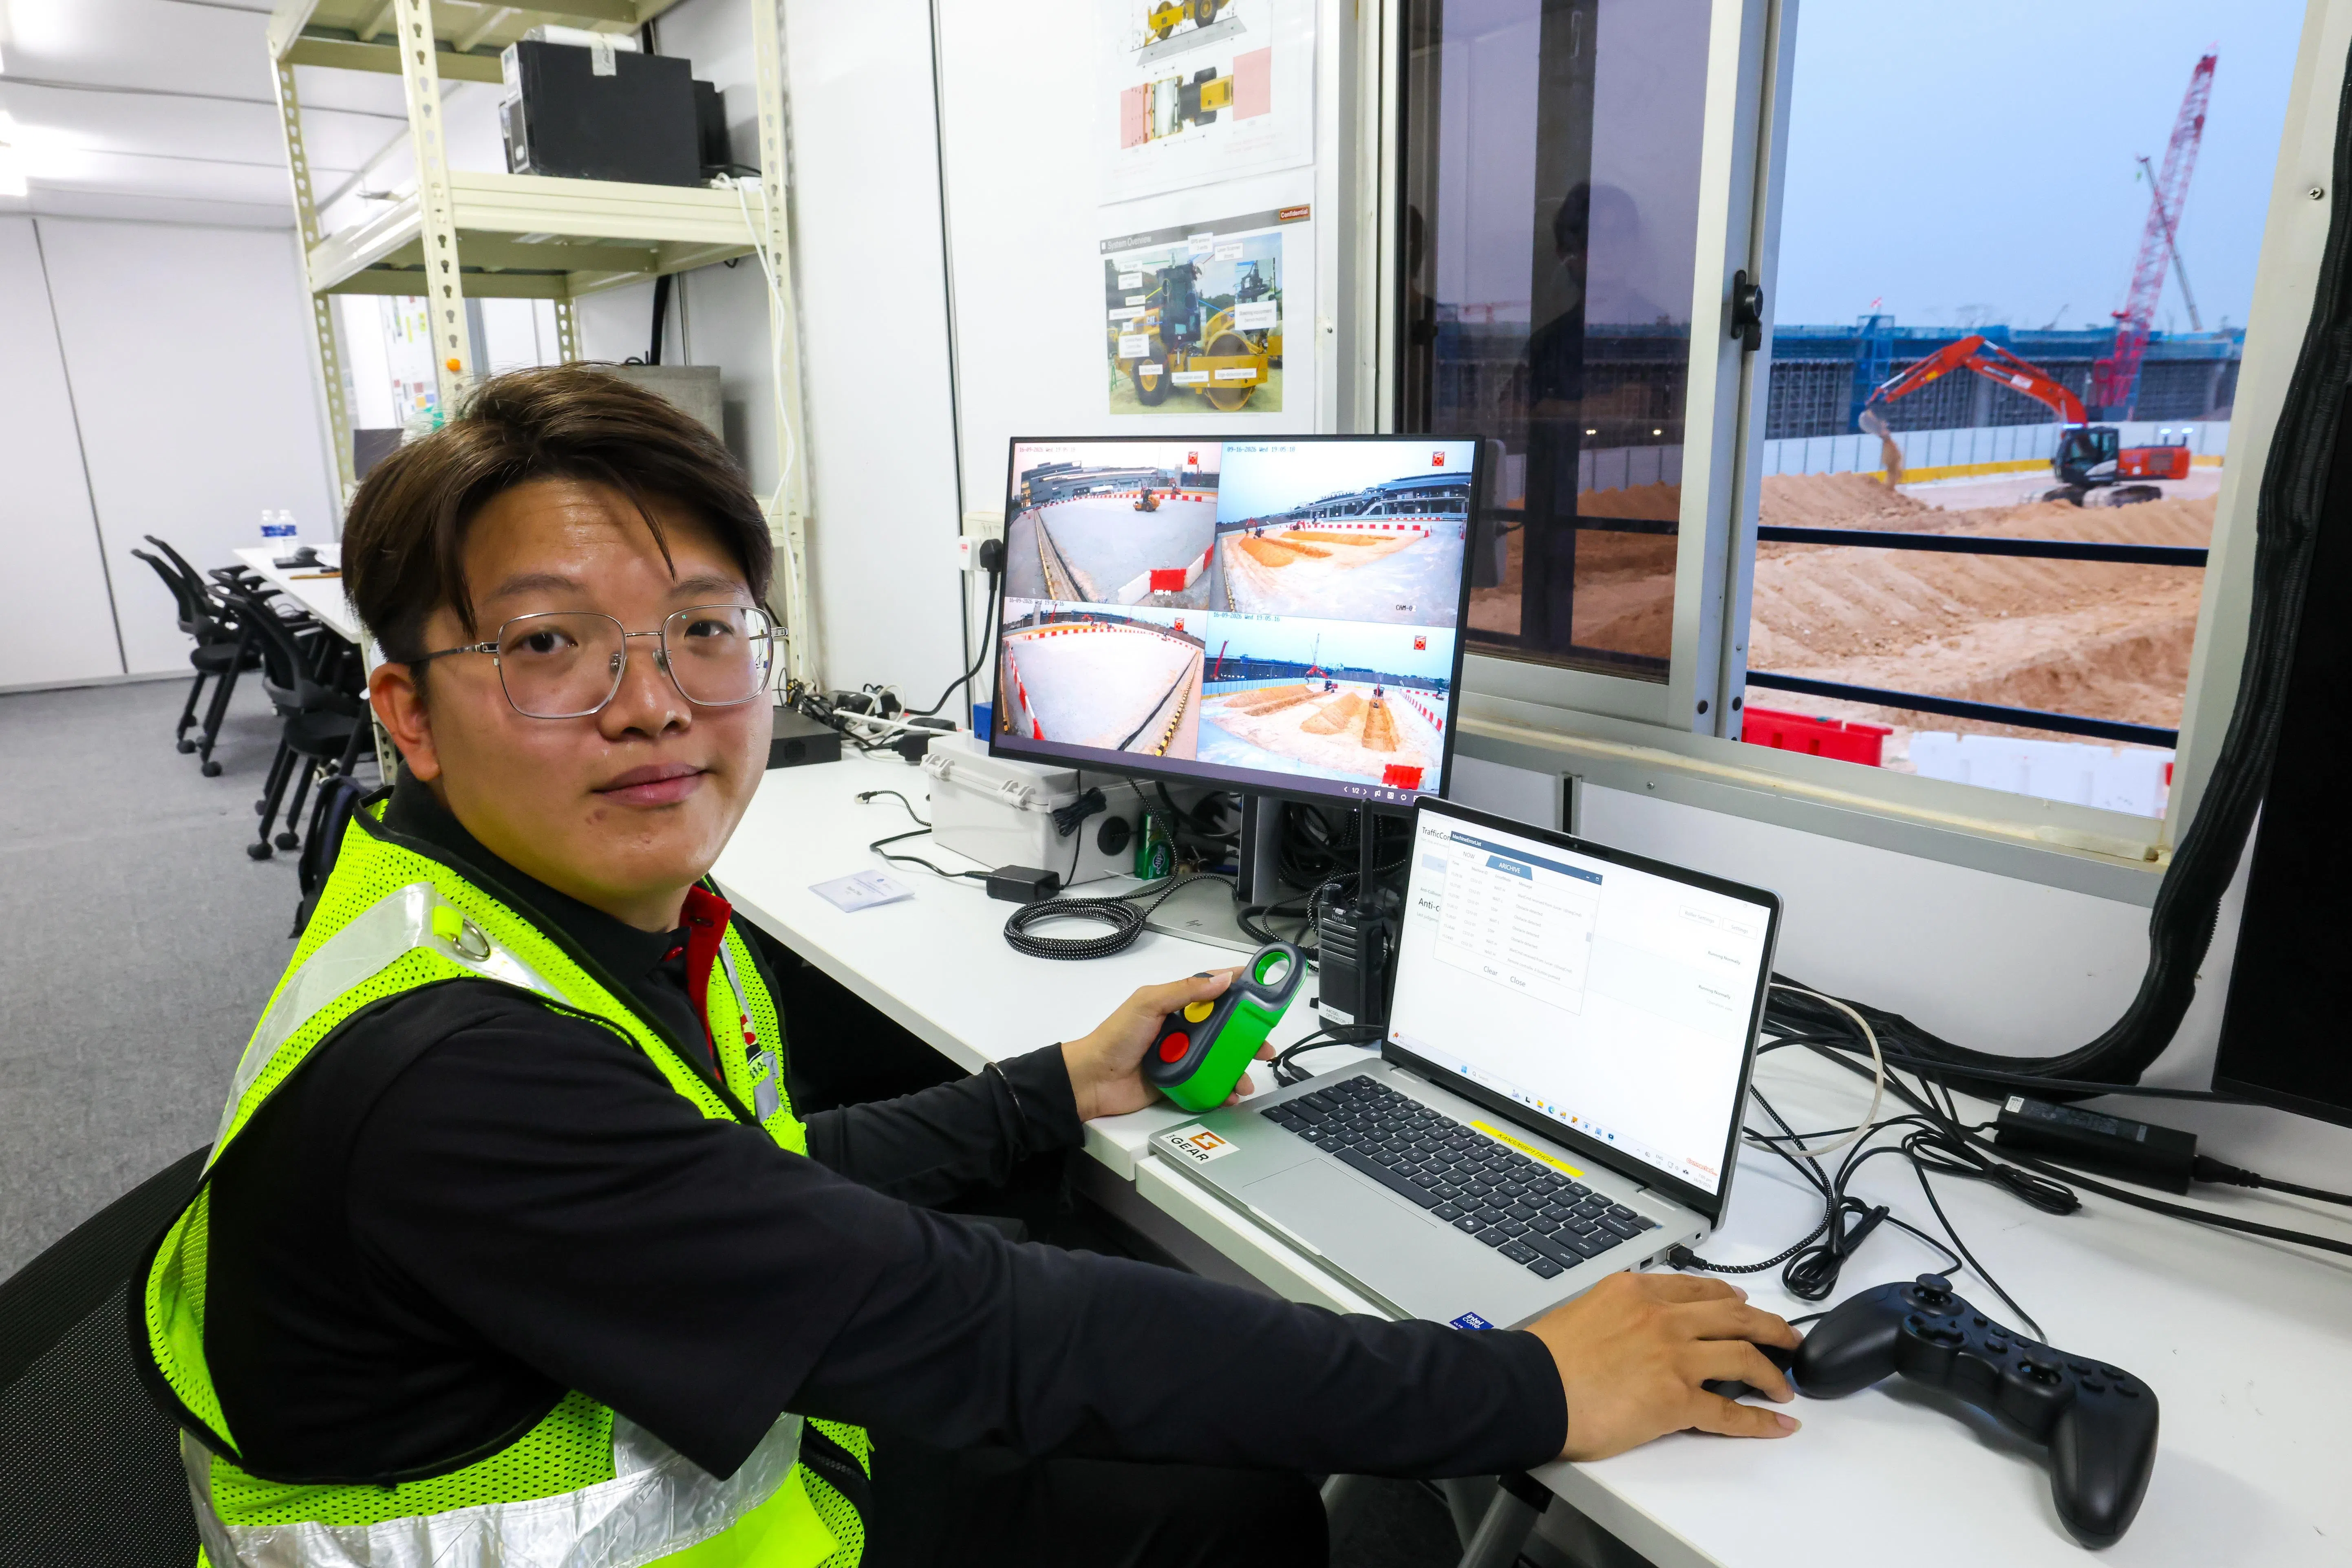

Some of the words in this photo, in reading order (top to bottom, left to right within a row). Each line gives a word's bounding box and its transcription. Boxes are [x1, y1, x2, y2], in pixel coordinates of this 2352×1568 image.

[1281, 208, 1308, 218] Confidential
[1108, 240, 1127, 251] System
[1128, 236, 1151, 246] Overview
[1452, 834, 1482, 847] MachineErrorList
[1155, 845, 1166, 875] eclipse
[1463, 851, 1475, 859] NOW
[1498, 862, 1521, 874] ARICHIVE
[1495, 874, 1511, 882] ErrorMode
[1518, 893, 1531, 901] WaitCmd
[1419, 898, 1441, 912] Anti-c
[1332, 914, 1346, 923] Hytera
[1698, 914, 1714, 924] Settings
[1731, 924, 1748, 934] Settings
[1708, 951, 1723, 959] Running
[1724, 956, 1741, 966] Normally
[1483, 966, 1498, 976] Clear
[1510, 976, 1526, 987] Close
[1698, 984, 1713, 994] Running
[1714, 990, 1731, 1000] Normally
[1326, 1012, 1346, 1024] OPERATOR
[1171, 1137, 1209, 1161] GEAR
[1693, 1177, 1712, 1189] 16/9/2026
[1607, 1218, 1628, 1231] backspace
[1578, 1242, 1591, 1250] enter
[1463, 1317, 1480, 1329] CORE
[1466, 1314, 1484, 1325] intel
